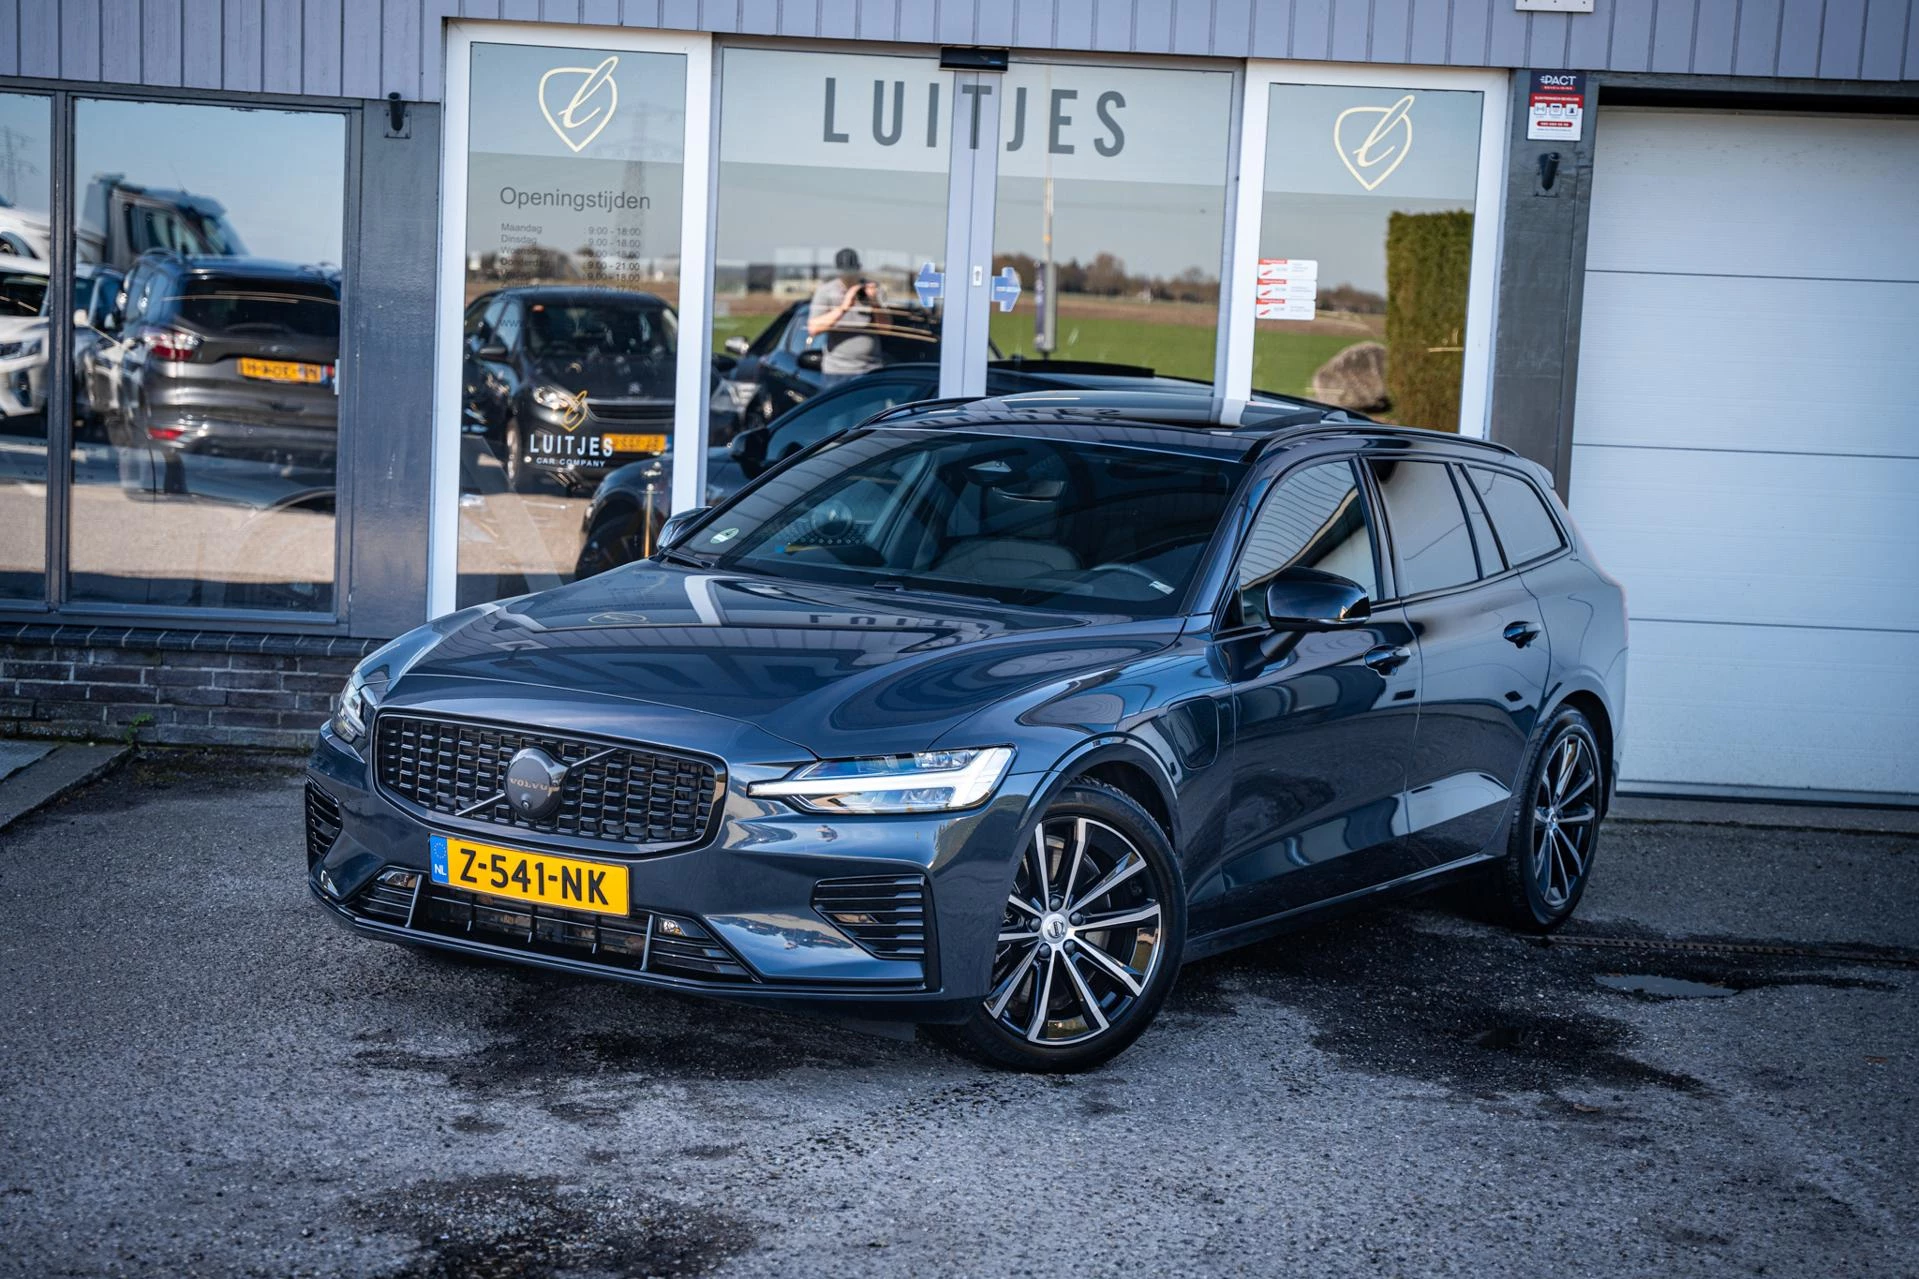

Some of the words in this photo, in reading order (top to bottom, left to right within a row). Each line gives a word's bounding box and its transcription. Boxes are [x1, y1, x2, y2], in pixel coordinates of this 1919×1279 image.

[1543, 74, 1577, 86] PACT
[823, 77, 1127, 157] LUITJES
[500, 186, 651, 213] Openingstijden
[501, 223, 542, 236] Maandag
[501, 234, 537, 247] Dinsdag
[529, 433, 614, 458] LUITJES
[536, 457, 556, 465] CAR
[559, 458, 606, 468] COMPANY
[510, 777, 548, 792] VOLVO
[433, 863, 447, 876] NL
[459, 848, 610, 906] Z-541-NK
